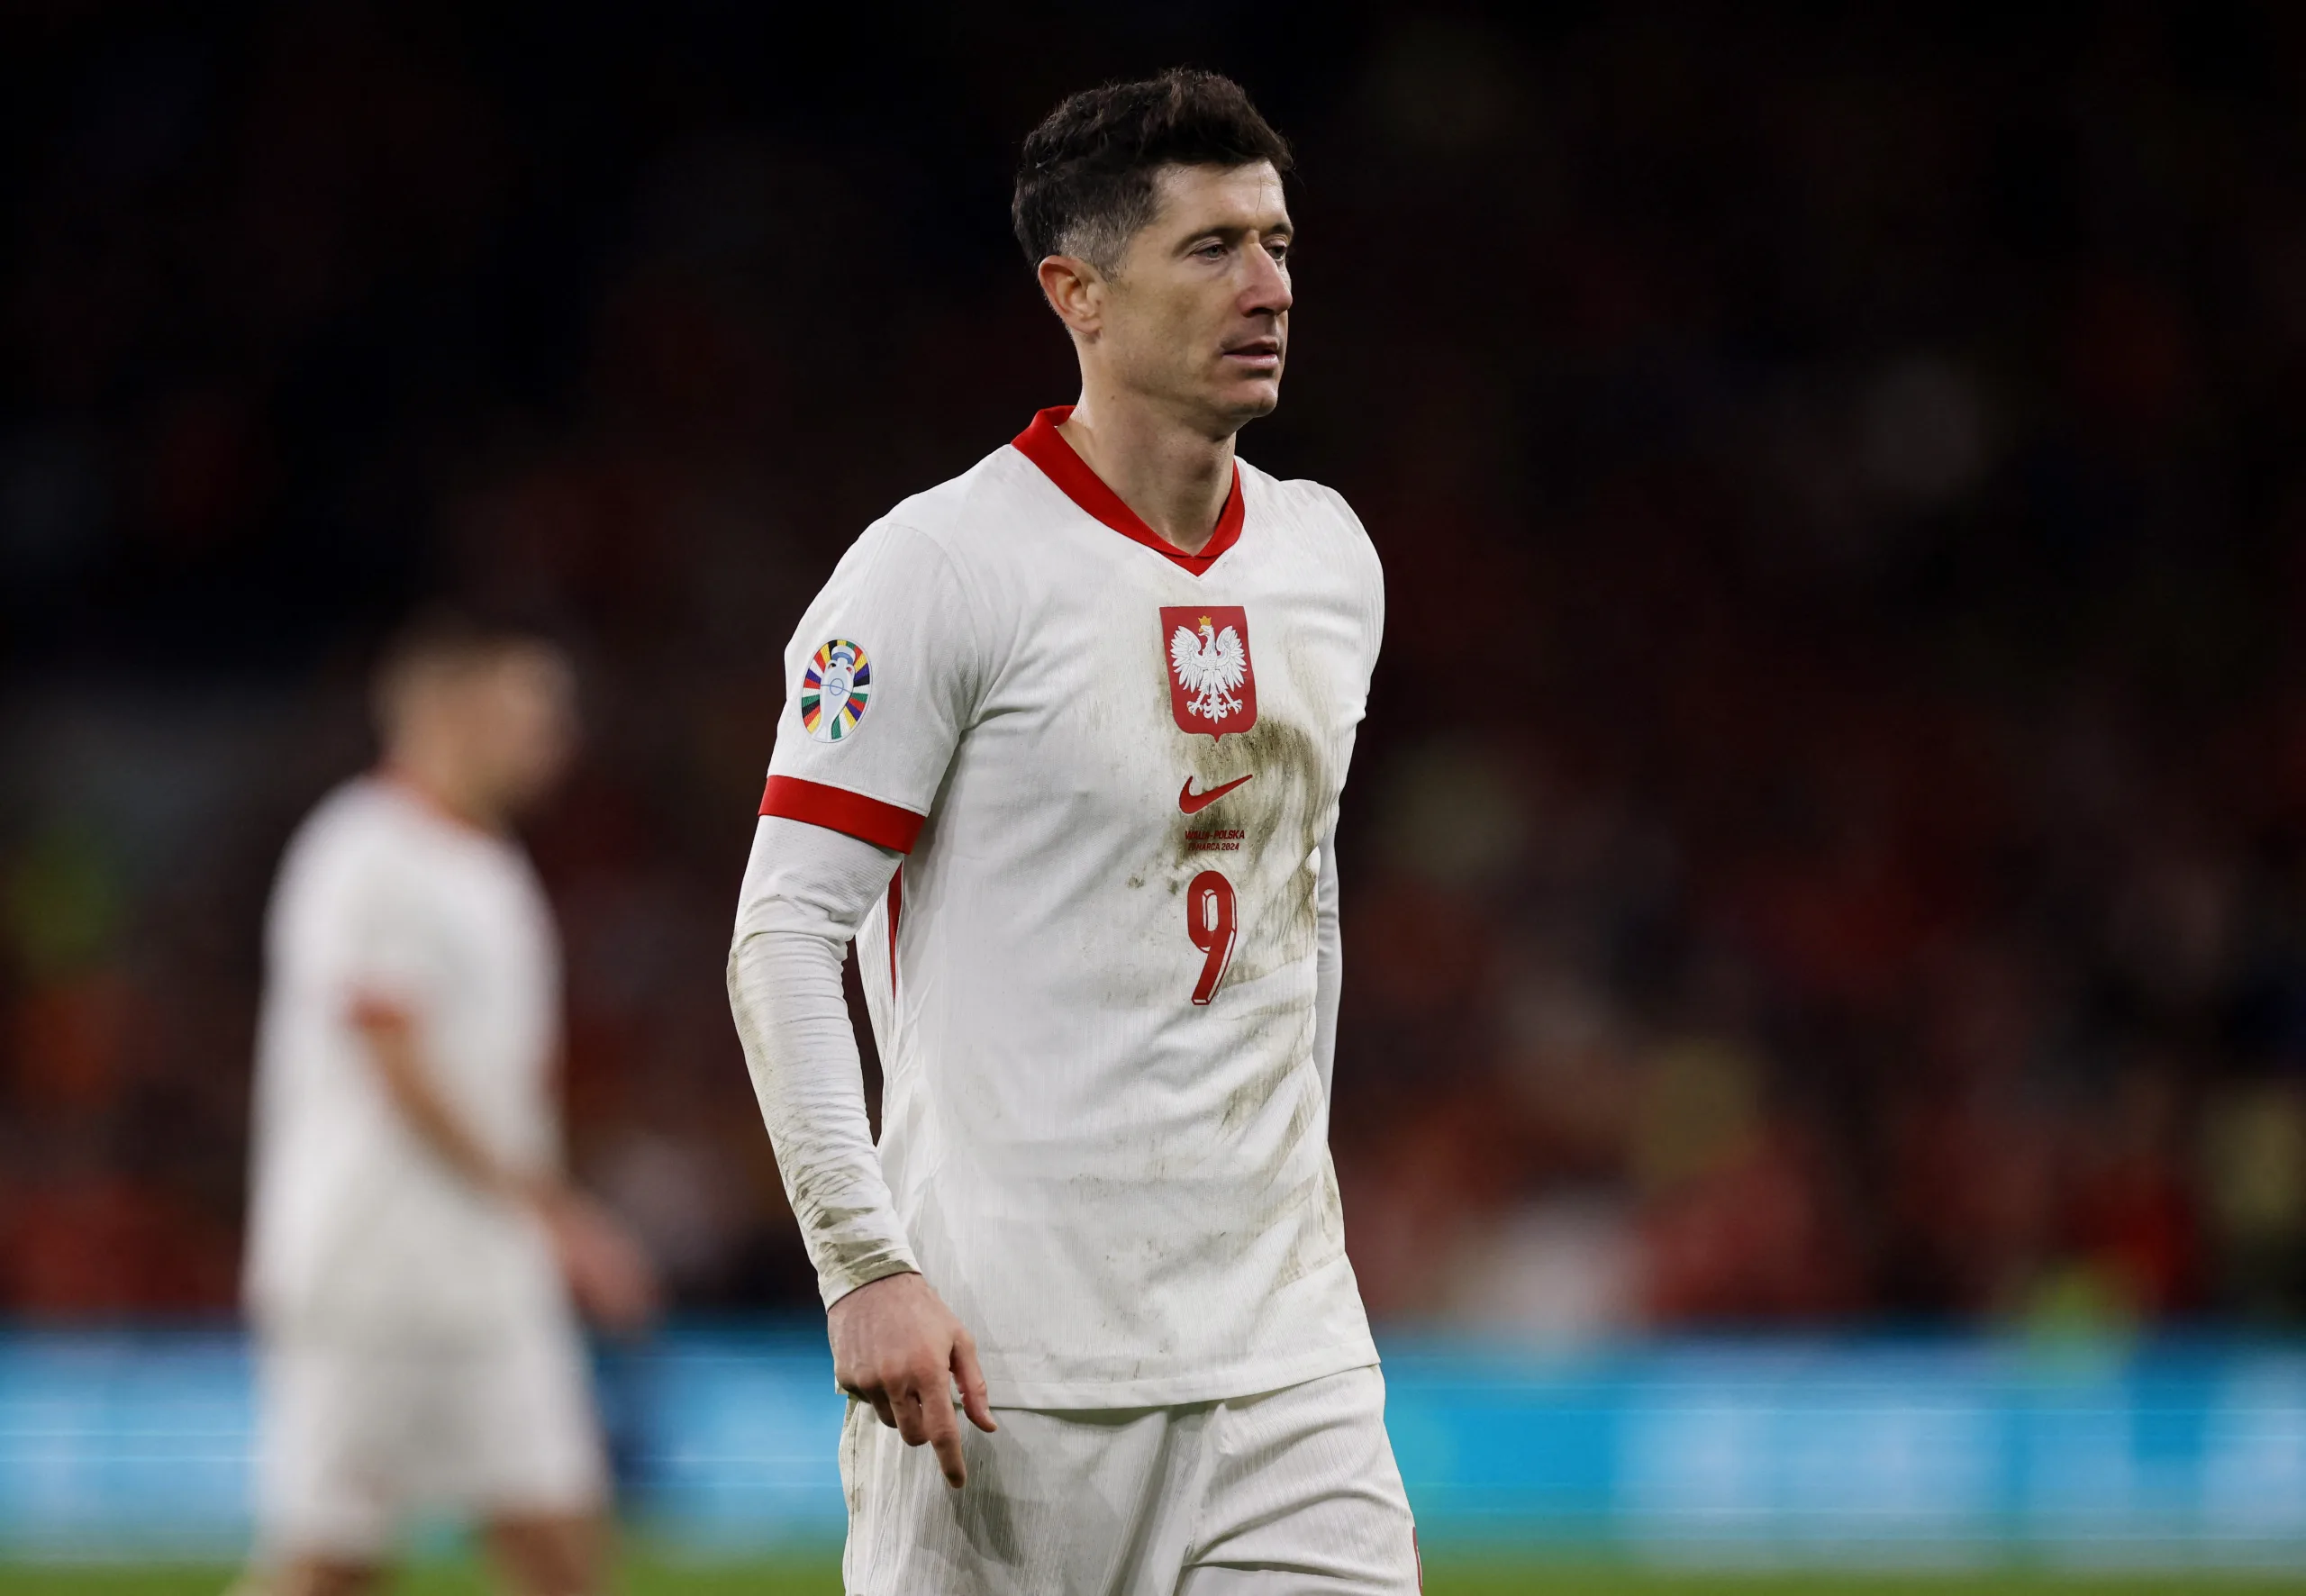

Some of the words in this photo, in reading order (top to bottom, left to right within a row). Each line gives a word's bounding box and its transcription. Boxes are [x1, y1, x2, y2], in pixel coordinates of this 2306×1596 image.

[1196, 843, 1220, 851] MARCA
[1221, 842, 1239, 851] 2024
[1187, 870, 1237, 1005] 9
